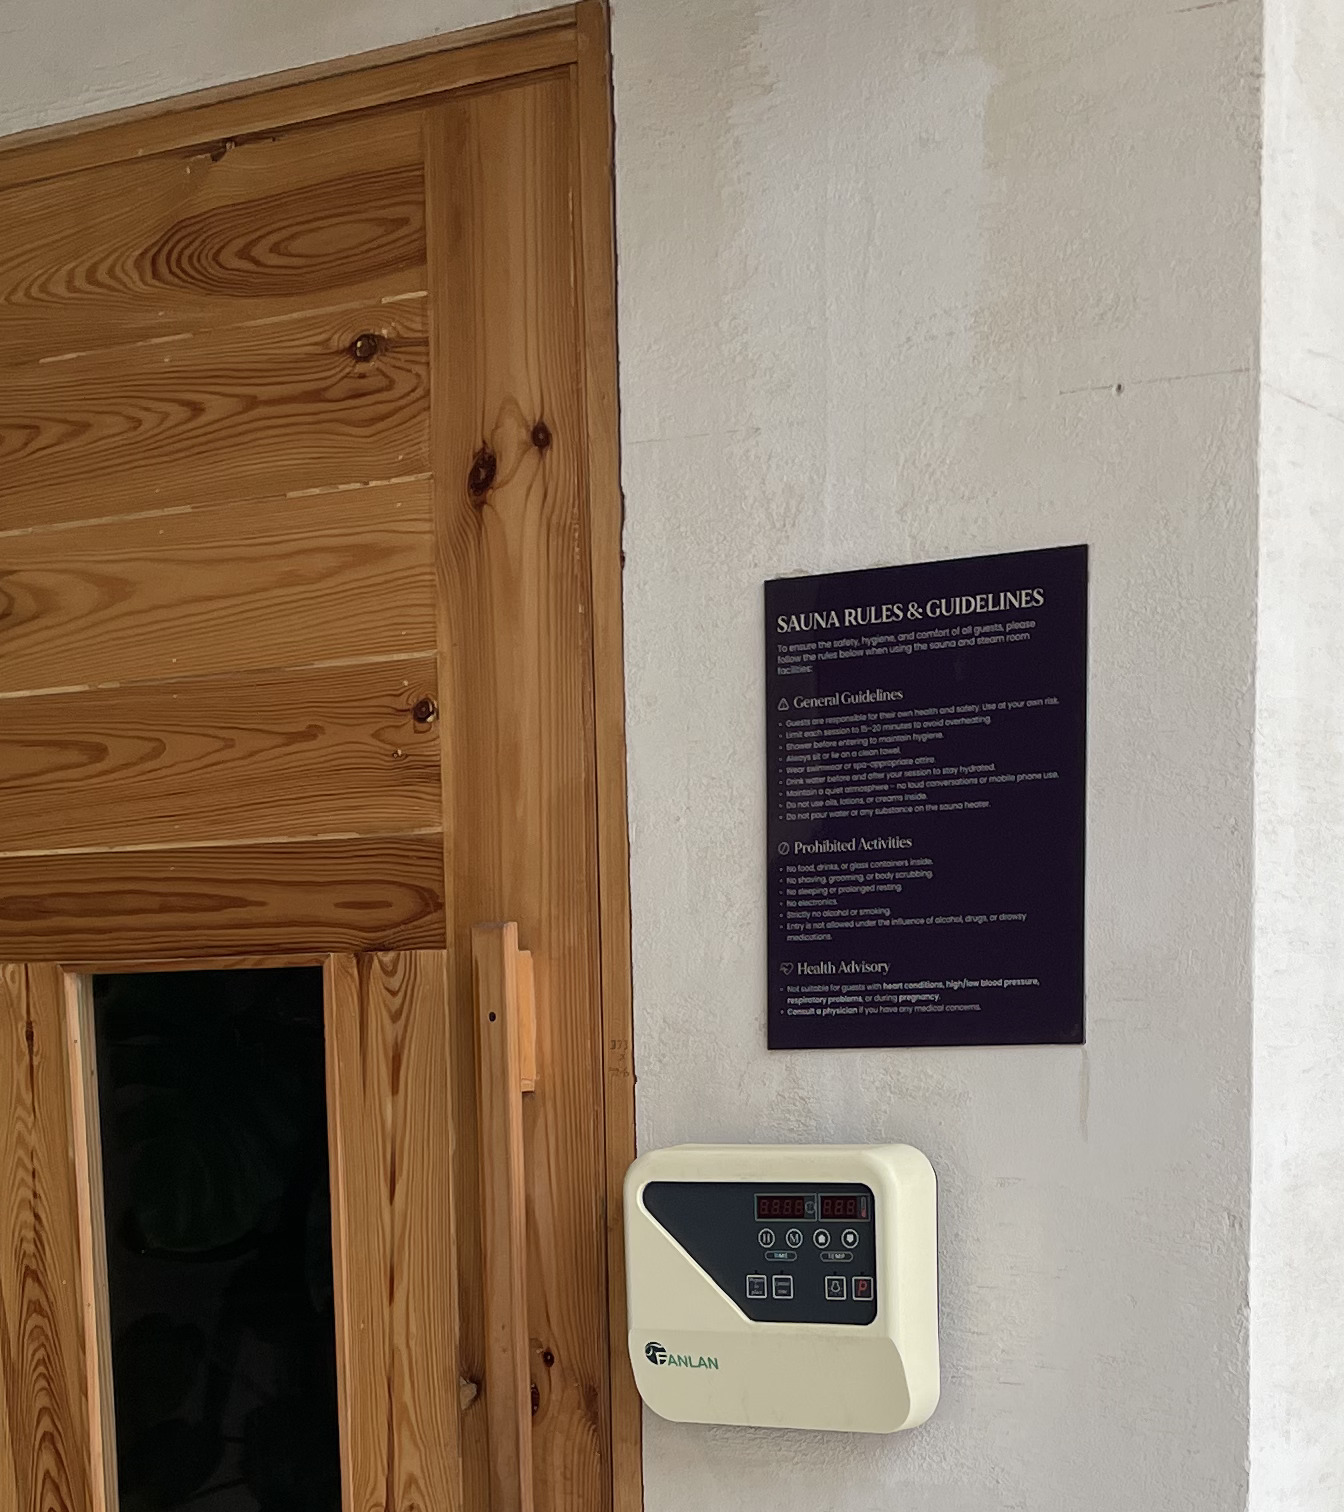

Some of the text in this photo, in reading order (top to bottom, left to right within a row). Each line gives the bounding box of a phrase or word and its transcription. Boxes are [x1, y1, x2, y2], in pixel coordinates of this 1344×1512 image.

[777, 588, 1044, 633] SAUNA RULES & GUIDELINES
[793, 688, 903, 708] General Guidelines
[794, 835, 912, 854] Prohibited Activities
[797, 960, 889, 975] Health Advisory
[789, 1233, 799, 1244] M
